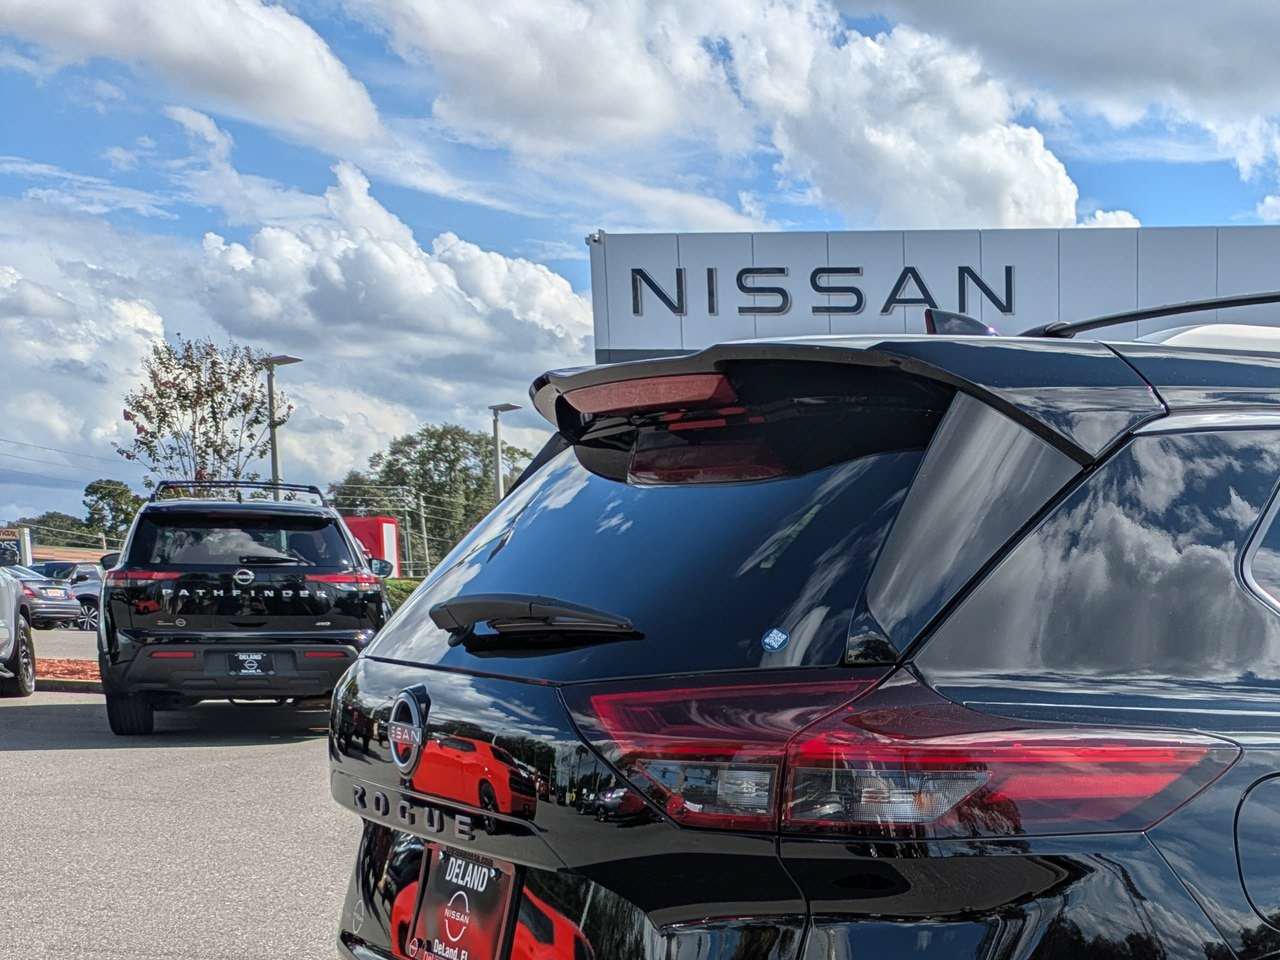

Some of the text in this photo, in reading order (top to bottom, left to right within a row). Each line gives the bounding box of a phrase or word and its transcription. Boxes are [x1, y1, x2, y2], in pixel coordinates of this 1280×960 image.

[631, 265, 1015, 316] NISSAN
[161, 589, 328, 598] PATHFINDER
[354, 784, 474, 841] ROGUE
[445, 856, 489, 893] DELAND
[444, 908, 471, 924] NISSAN
